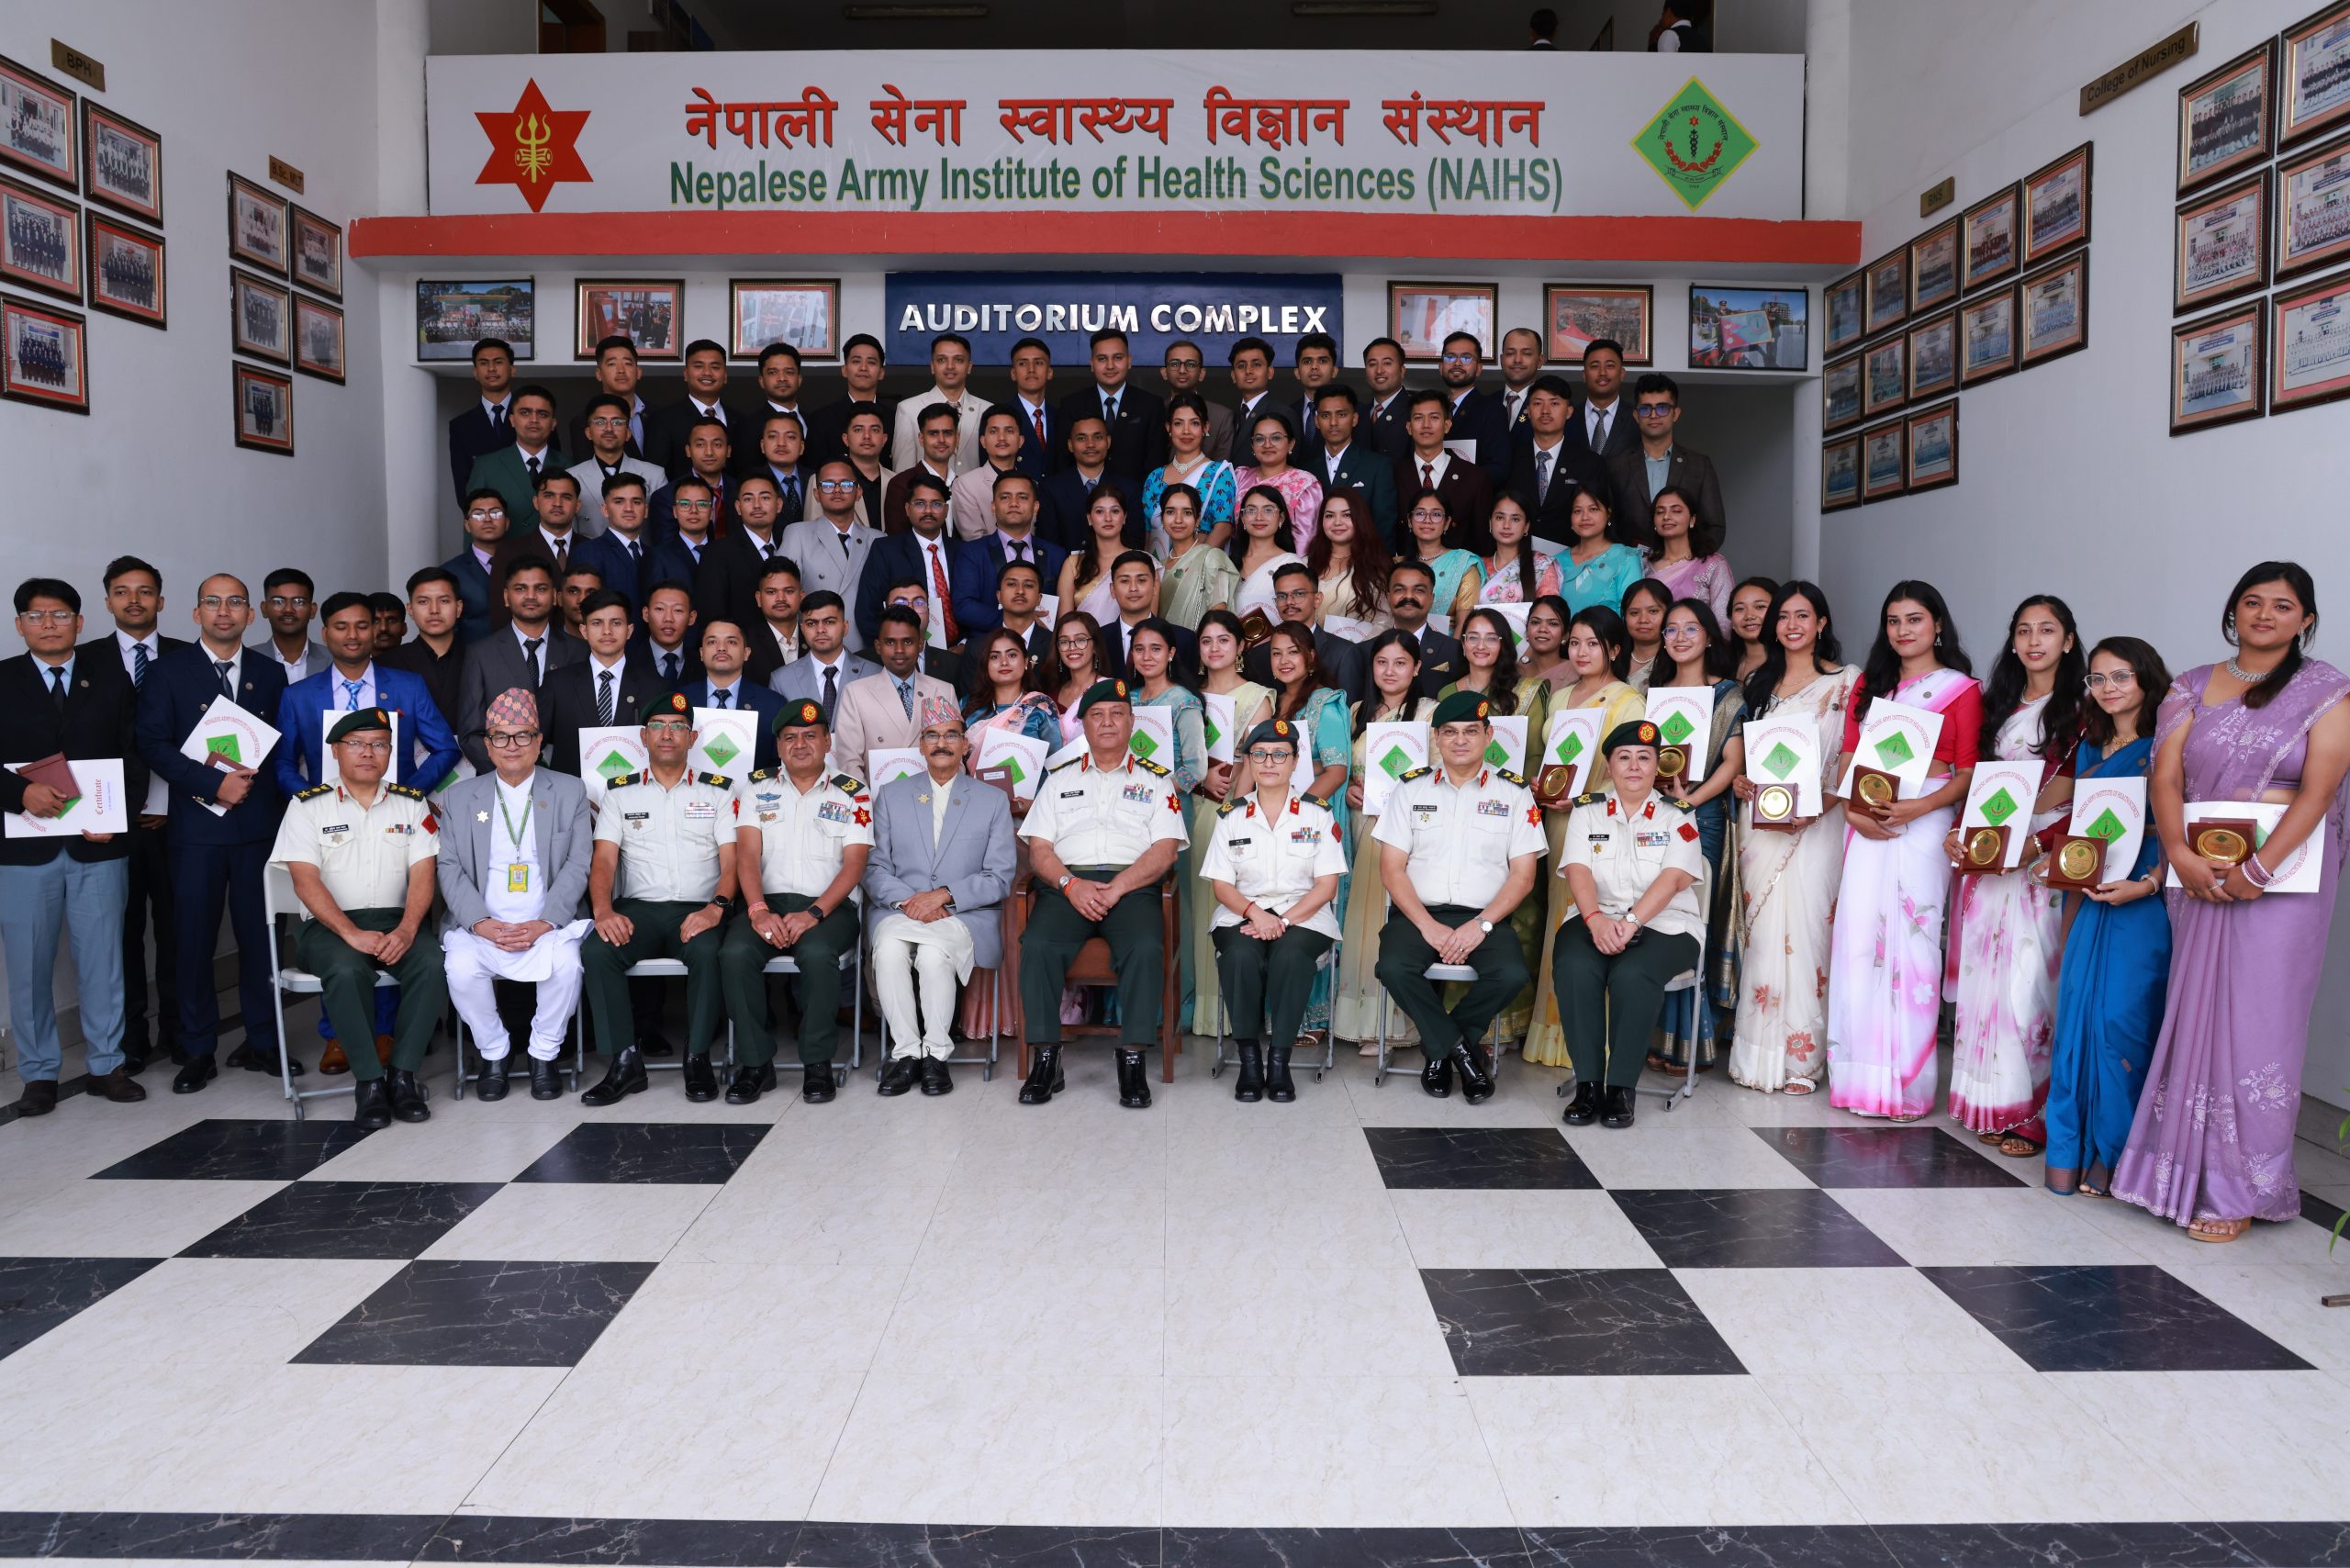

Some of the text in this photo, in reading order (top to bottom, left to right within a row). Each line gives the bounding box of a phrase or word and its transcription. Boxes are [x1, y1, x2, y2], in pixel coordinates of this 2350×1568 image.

[67, 52, 92, 78] BPH
[2087, 38, 2185, 102] College of Nursing
[685, 84, 1545, 151] नेपाली सेना स्वास्थ्य विज्ञान संस्थान
[670, 155, 1562, 213] Nepalese Army Institute of Health Sciences (NAIHS)
[899, 303, 1328, 334] AUDITORIUM COMPLEX
[95, 778, 104, 815] Certificate
